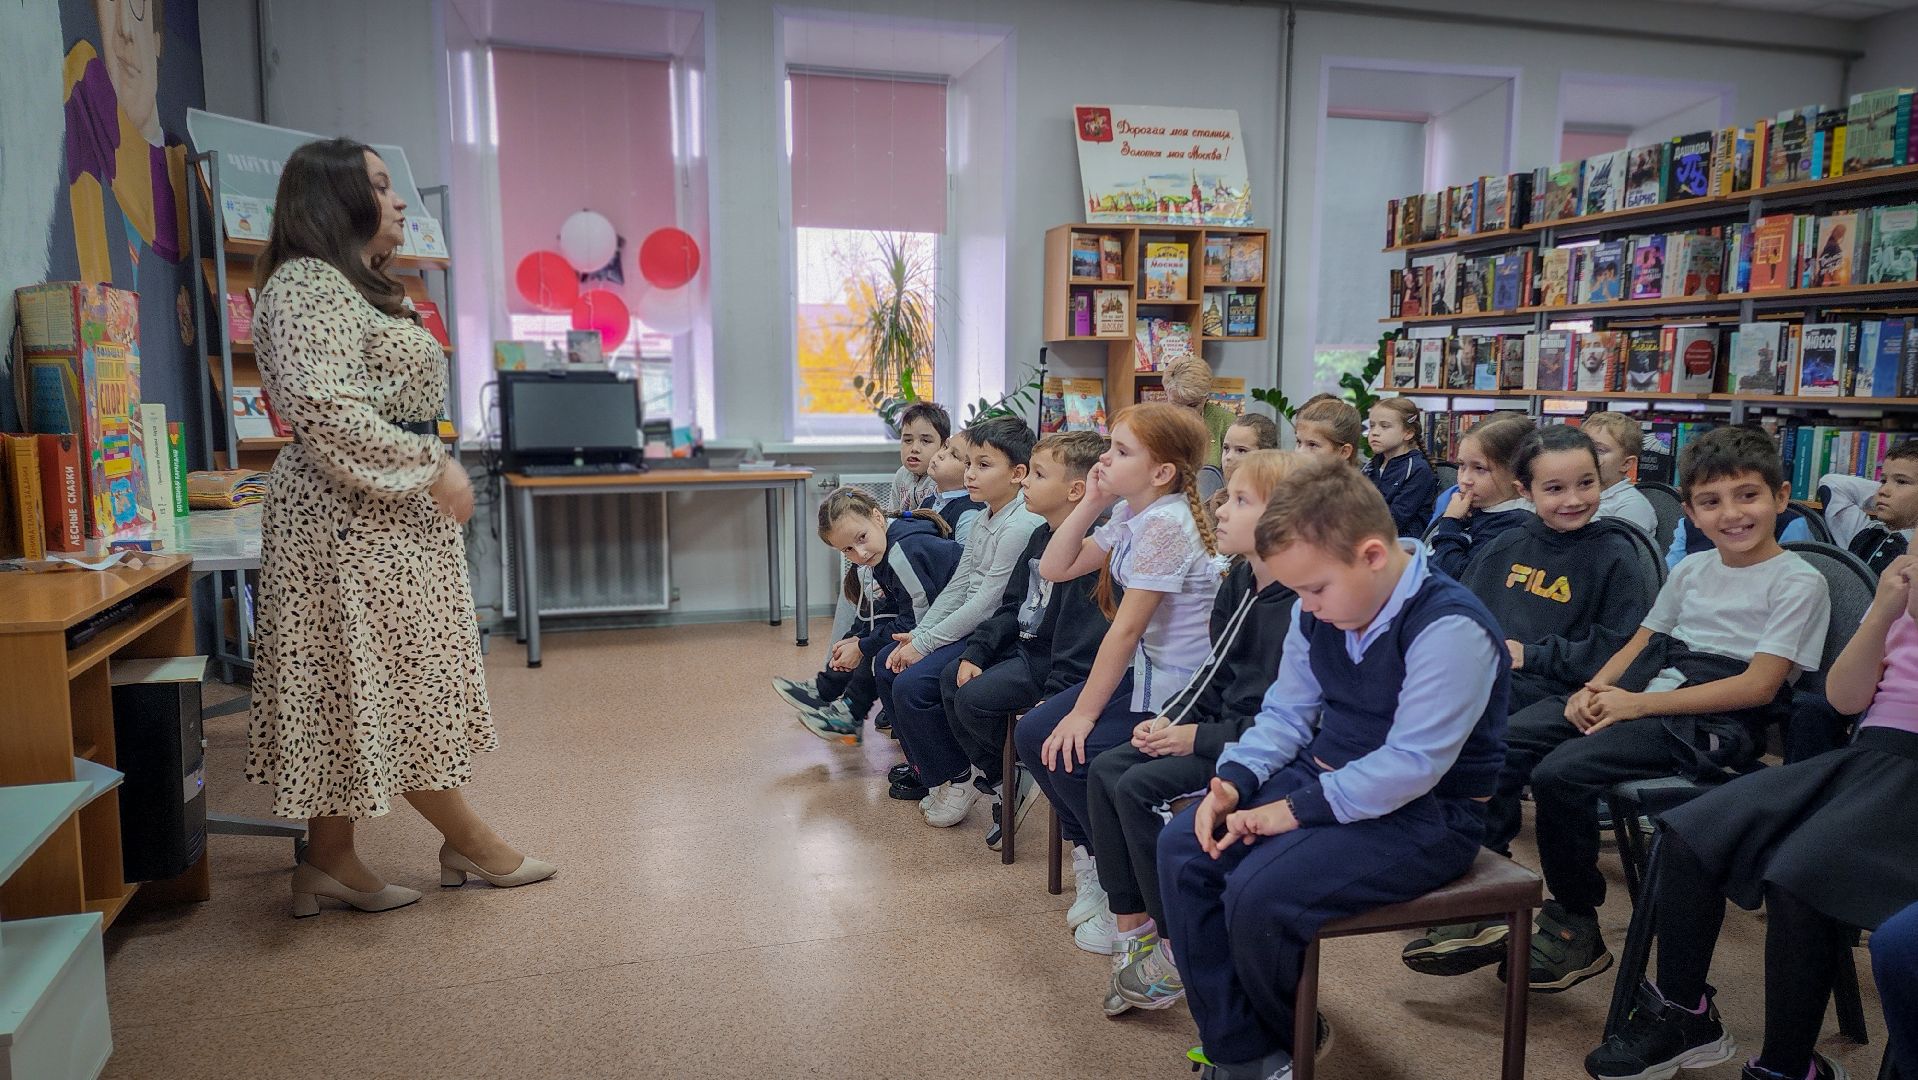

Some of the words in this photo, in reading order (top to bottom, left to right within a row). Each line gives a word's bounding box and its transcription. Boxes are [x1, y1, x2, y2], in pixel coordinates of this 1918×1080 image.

[1116, 119, 1166, 138] Дорогая
[1169, 127, 1189, 136] моя
[1120, 140, 1162, 158] Золотая
[1166, 149, 1184, 159] моя
[99, 383, 127, 415] СПОРТ
[64, 466, 78, 504] СКАЗКИ
[67, 508, 81, 546] ЛЕСНЫЕ
[1505, 563, 1572, 603] FILA
